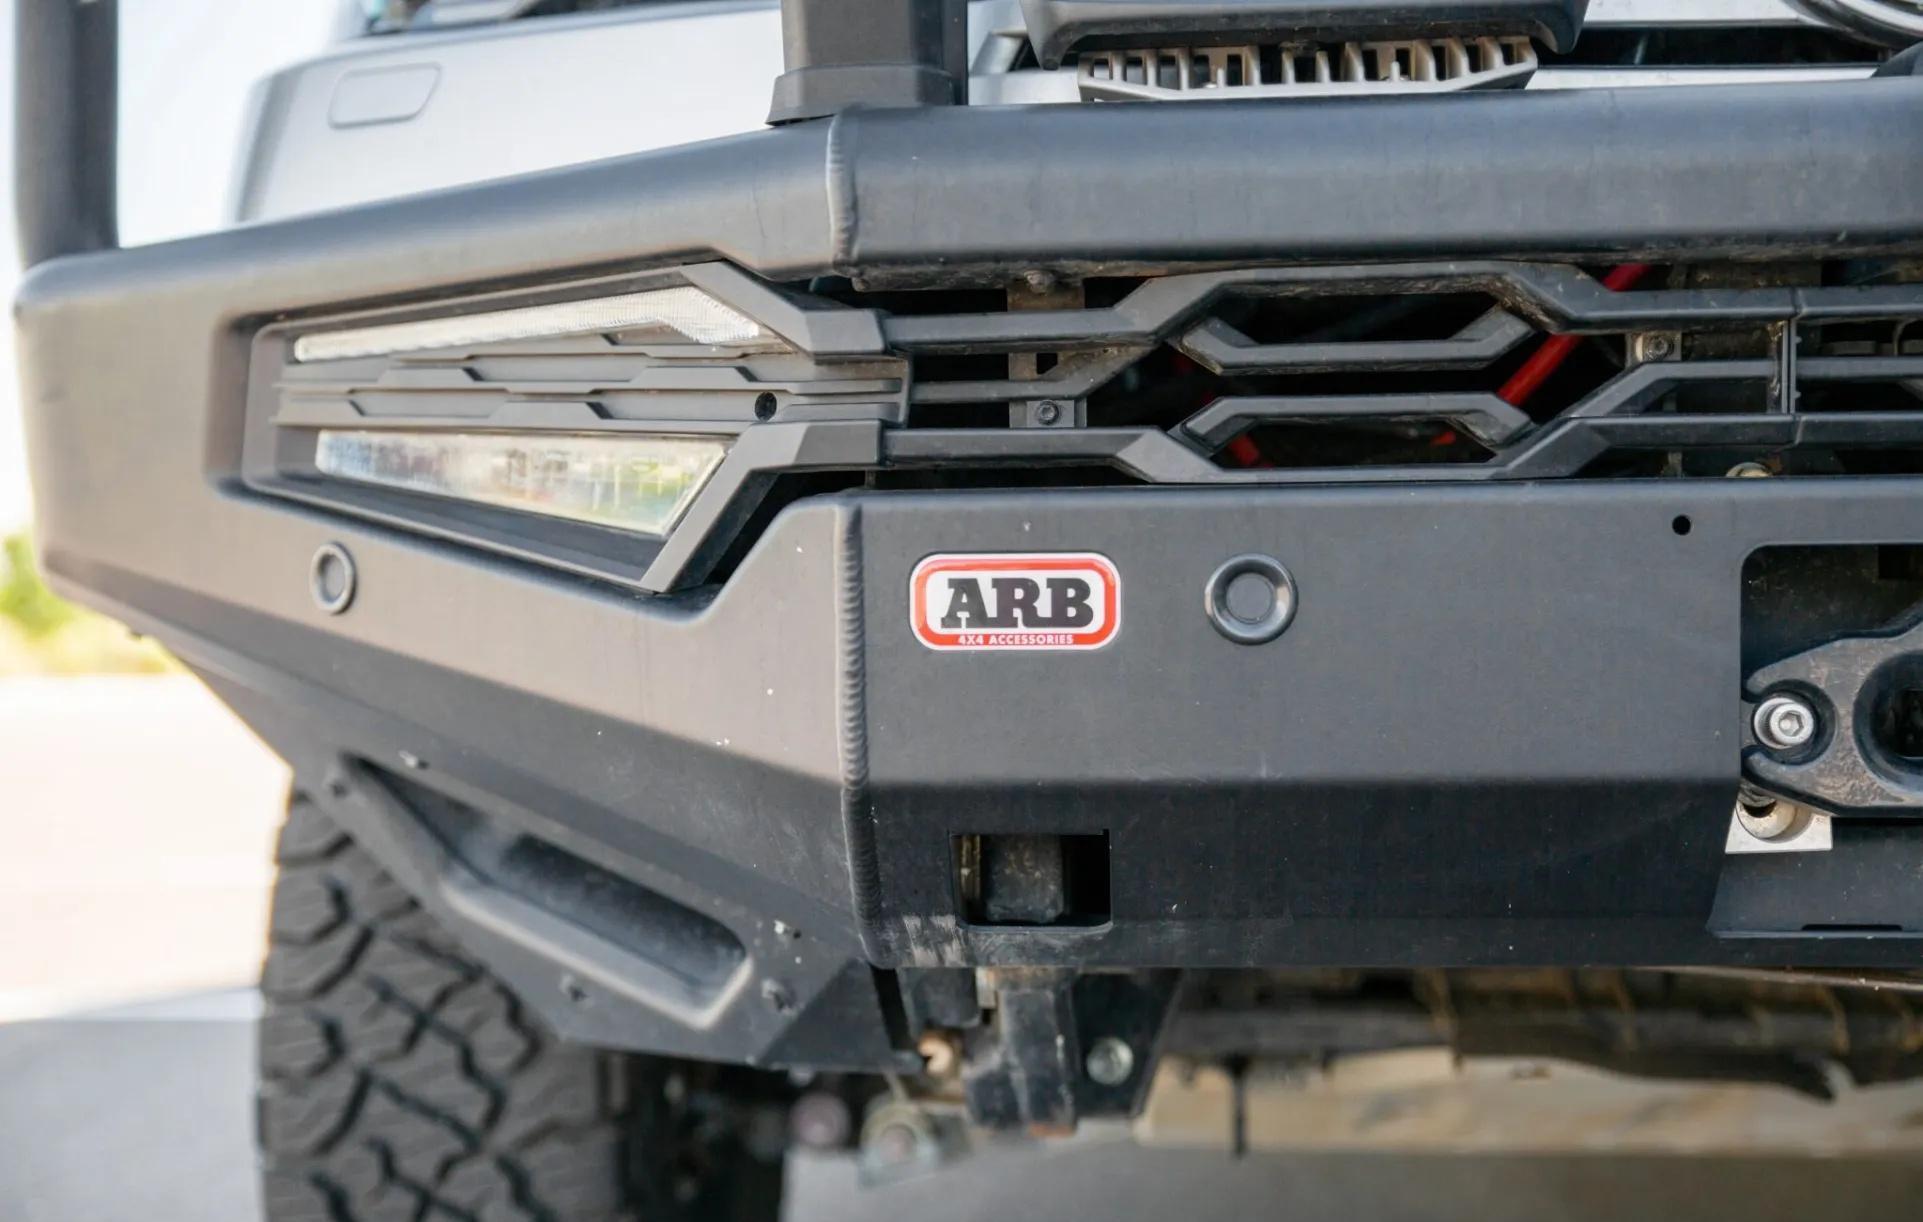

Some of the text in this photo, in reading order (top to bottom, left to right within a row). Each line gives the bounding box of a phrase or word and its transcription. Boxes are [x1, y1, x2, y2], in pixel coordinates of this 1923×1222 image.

[941, 578, 1094, 629] ARB
[958, 634, 1074, 645] 4X4 ACCESSORIES
